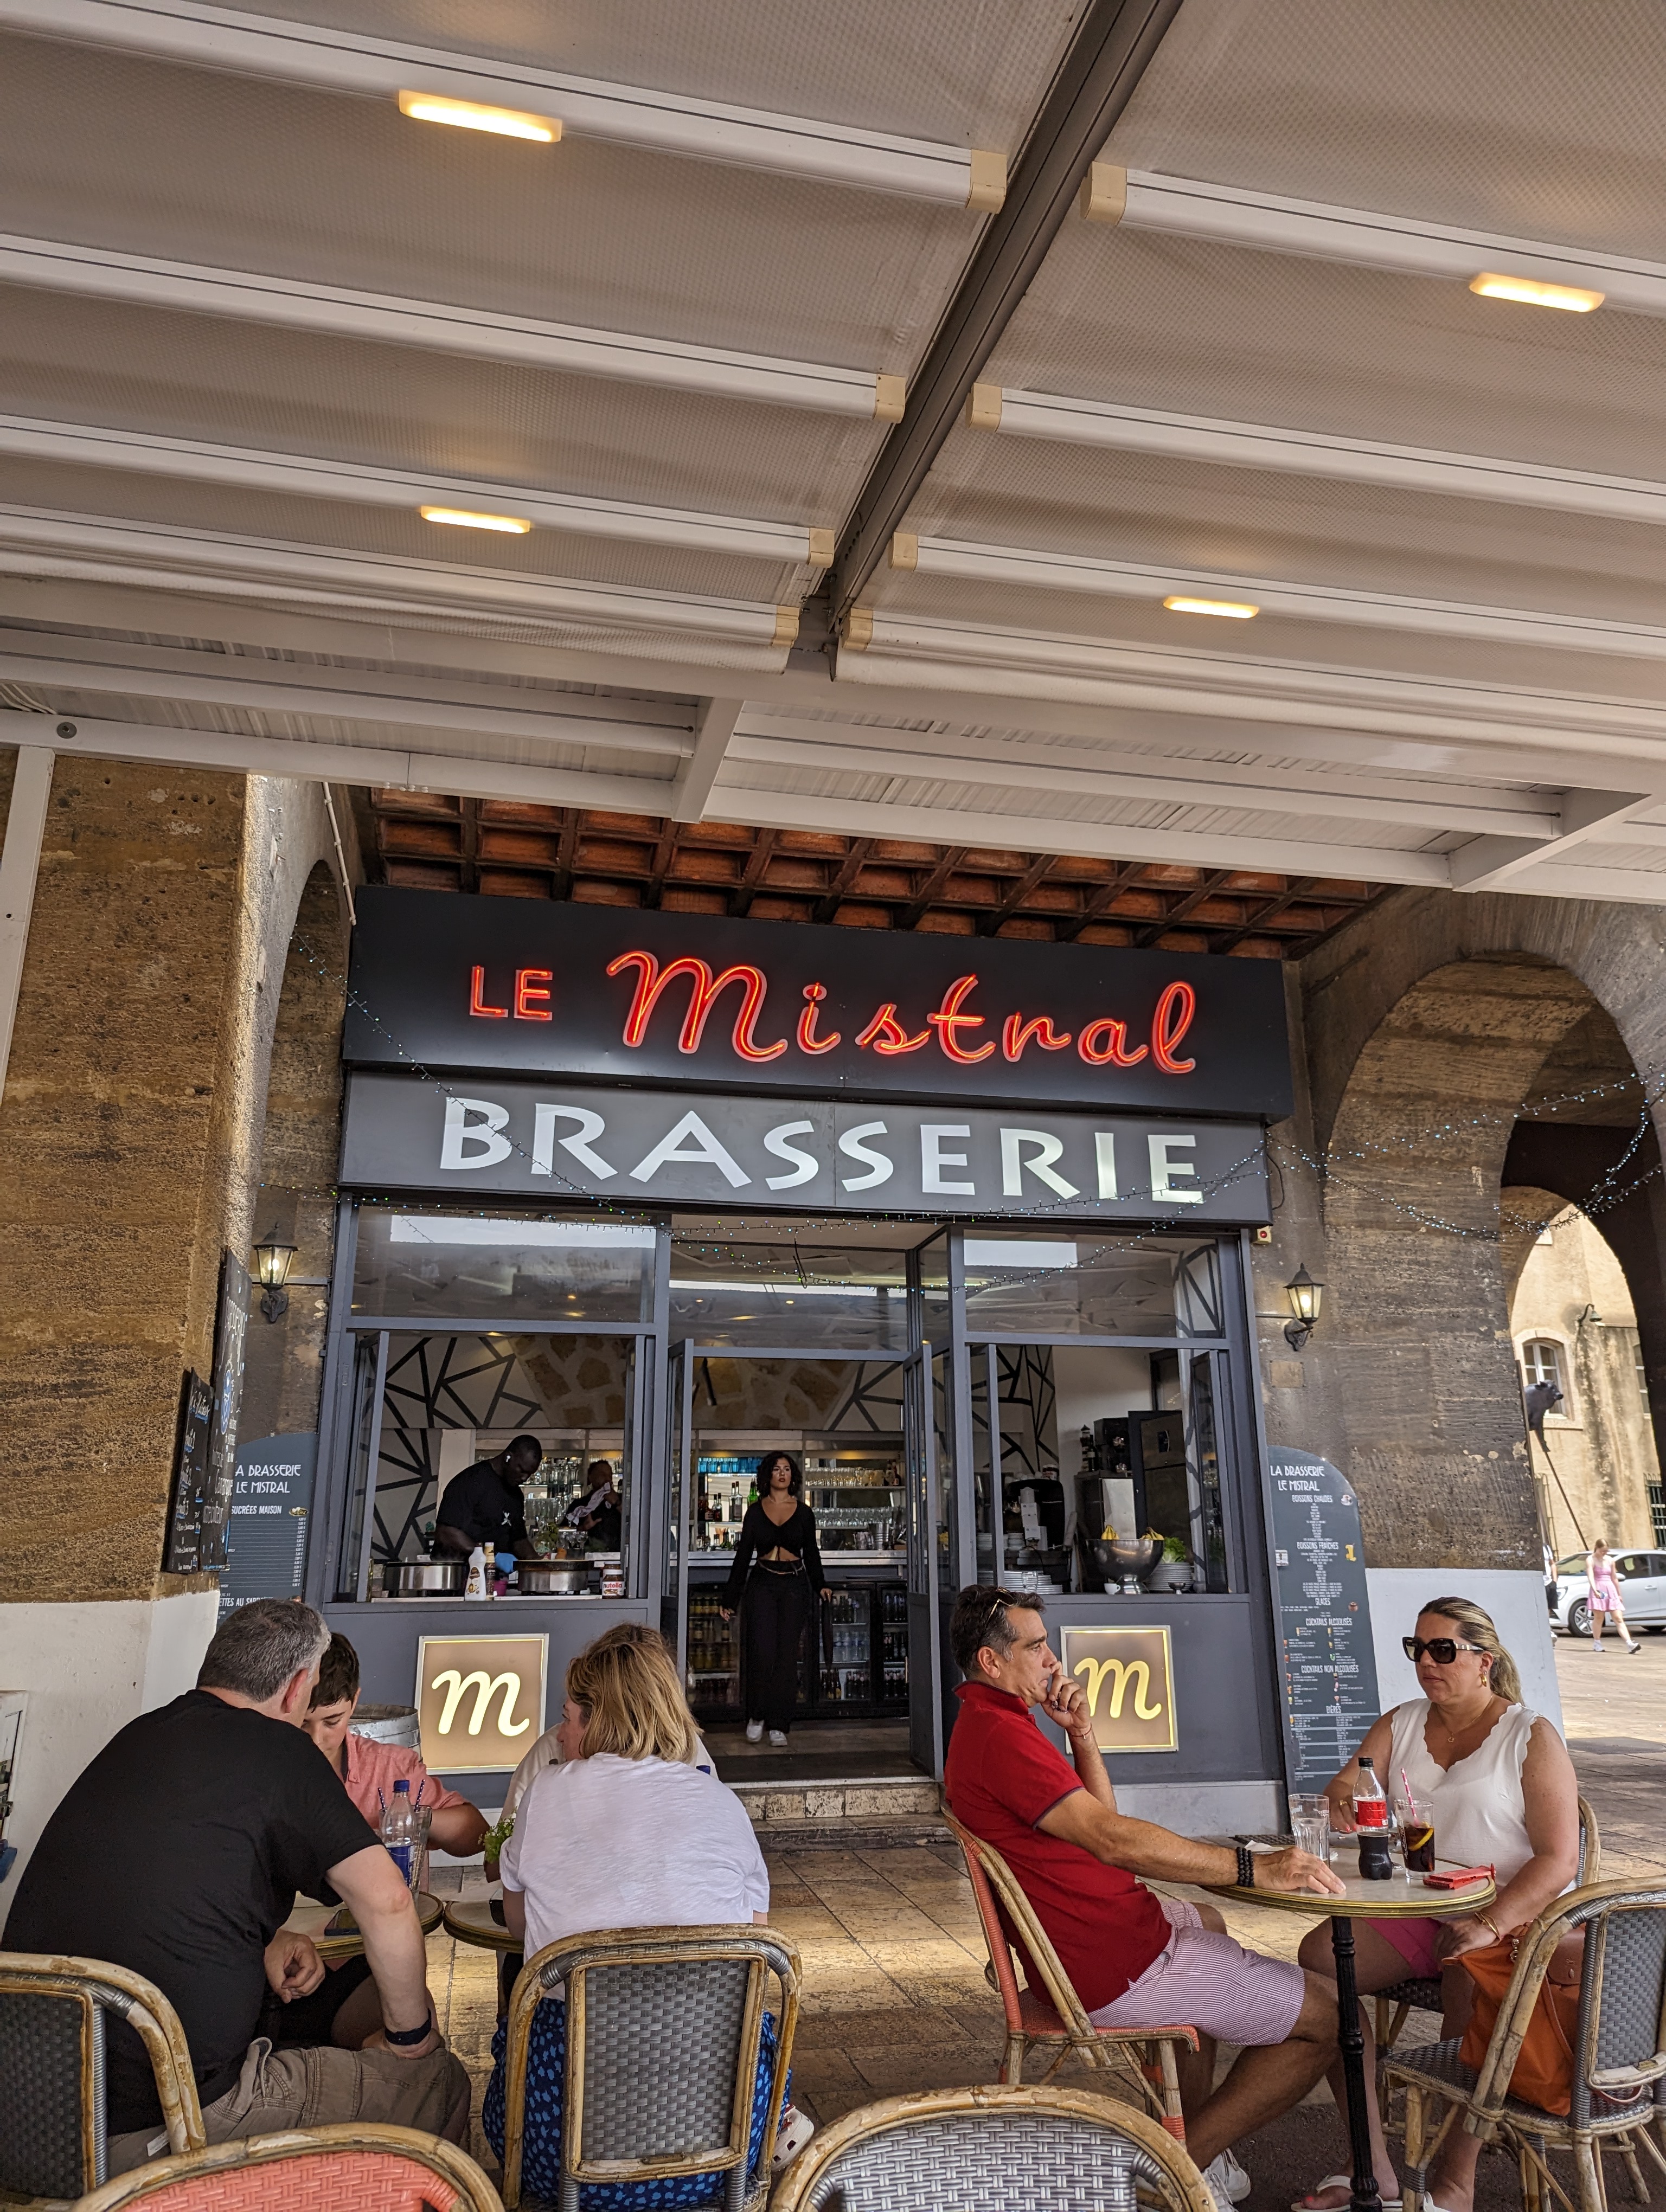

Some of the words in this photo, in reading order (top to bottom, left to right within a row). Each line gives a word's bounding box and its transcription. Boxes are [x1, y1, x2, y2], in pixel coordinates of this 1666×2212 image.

[470, 965, 553, 1021] LE
[605, 950, 1197, 1075] Mistral
[439, 1098, 1206, 1204] BRASSERIE
[234, 1464, 245, 1476] A
[248, 1464, 302, 1476] BRASSERIE
[1270, 1465, 1283, 1476] LA
[1284, 1465, 1325, 1477] BRASSERIE
[236, 1481, 248, 1493] LE
[251, 1481, 291, 1493] MISTRAL
[1278, 1480, 1287, 1491] LE
[1289, 1480, 1320, 1491] MISTRAL
[1291, 1495, 1313, 1503] BOISSONS
[1314, 1495, 1334, 1503] CHAUDES
[232, 1504, 258, 1514] SUCRÉES
[259, 1505, 283, 1514] MAISON
[1297, 1541, 1317, 1550] BOISSONS
[1318, 1541, 1339, 1550] FRAÎCHES
[219, 1597, 234, 1606] ETTES
[236, 1597, 244, 1606] AU
[1305, 1618, 1328, 1626] COCKTAILS
[1329, 1617, 1353, 1626] ALCOOLISÉS
[1302, 1664, 1323, 1673] COCKTAILS
[1324, 1664, 1334, 1673] NON
[1335, 1664, 1359, 1673] ALCOOLISÉS
[431, 1670, 530, 1737] m
[1326, 1705, 1342, 1713] BIÈRES
